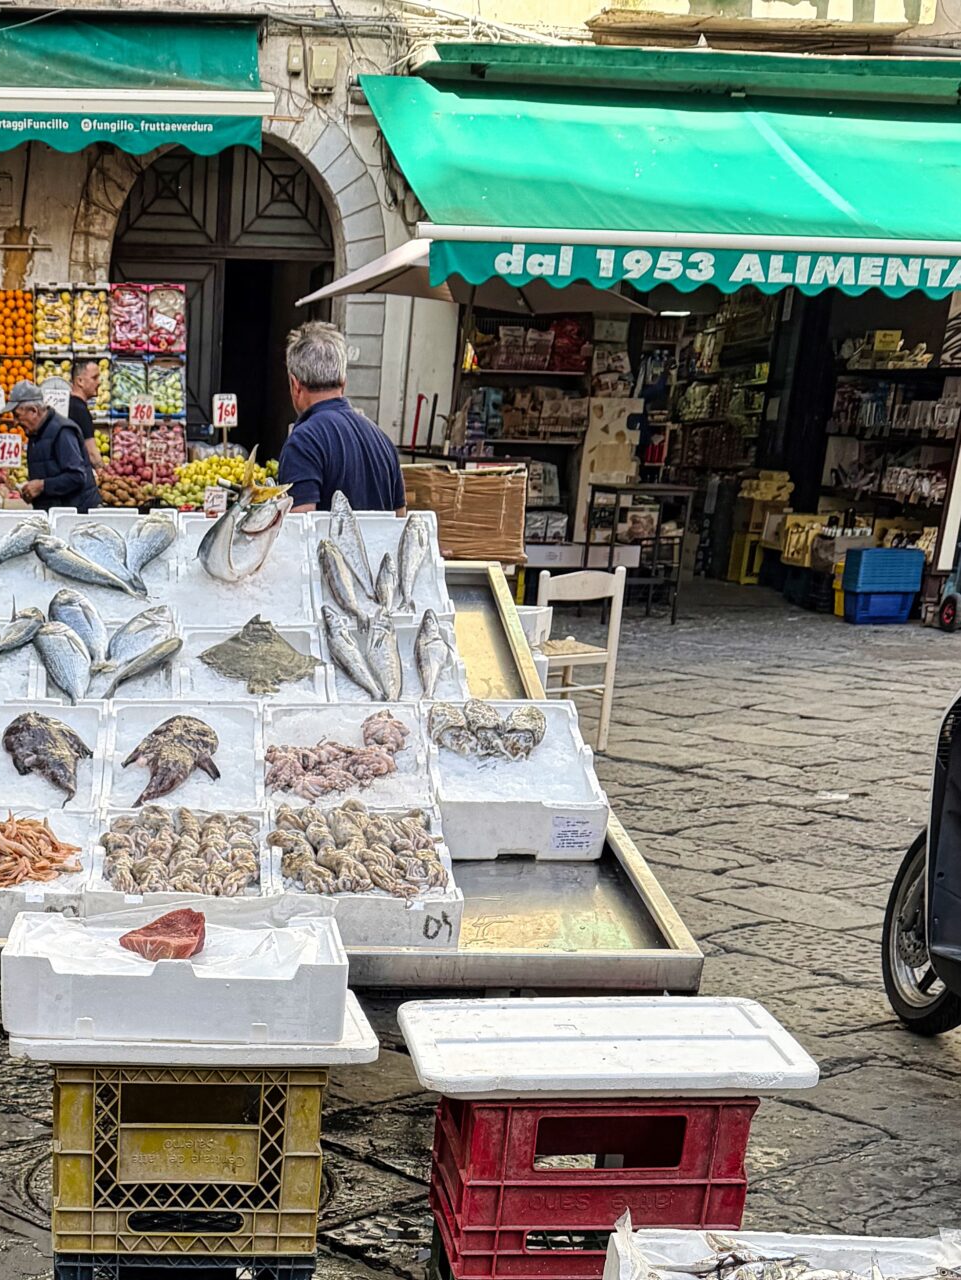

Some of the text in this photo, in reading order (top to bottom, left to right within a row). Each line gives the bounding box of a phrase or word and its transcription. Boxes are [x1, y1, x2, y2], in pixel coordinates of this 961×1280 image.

[92, 118, 213, 132] fungillo_fruttaeverdura
[494, 244, 573, 276] dal
[595, 250, 716, 280] 1953
